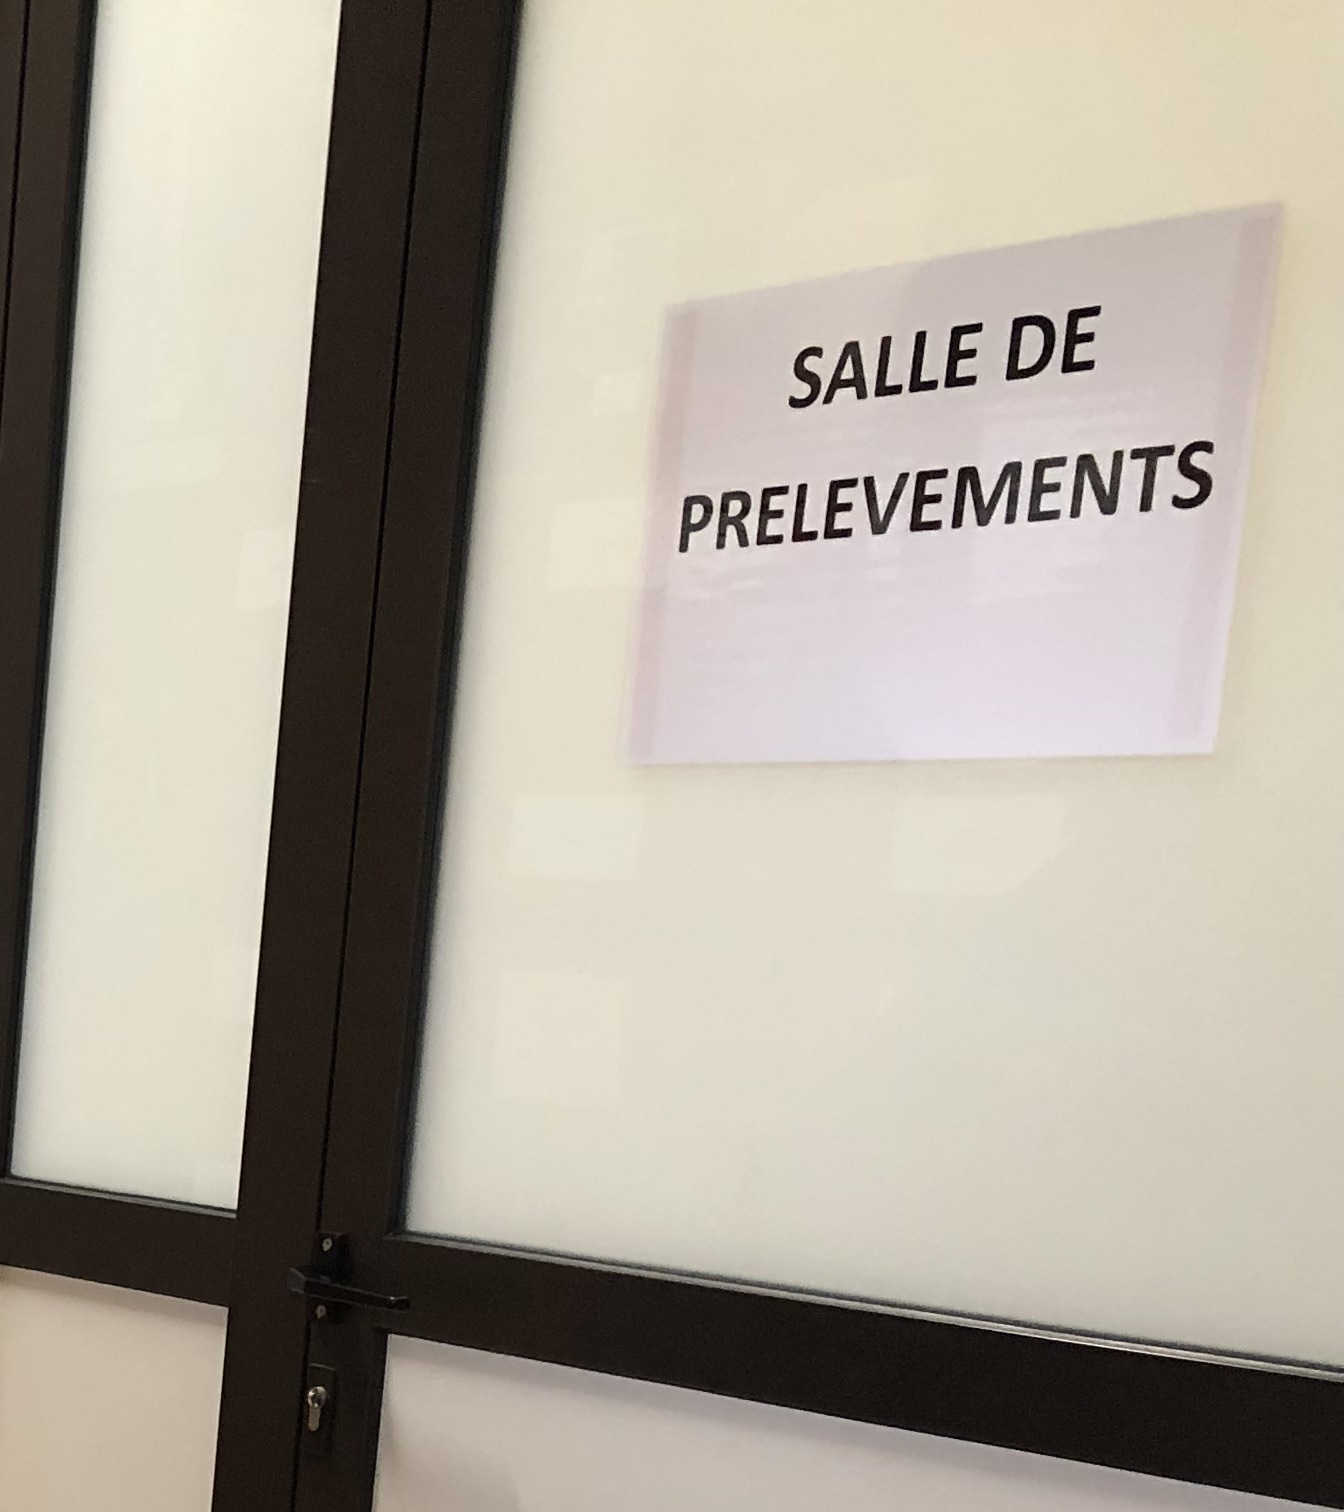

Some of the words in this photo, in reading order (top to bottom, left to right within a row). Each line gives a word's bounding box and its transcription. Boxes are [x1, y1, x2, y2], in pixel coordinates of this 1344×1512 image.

[788, 322, 983, 409] SALLE
[1005, 305, 1102, 382] DE
[678, 440, 1214, 554] PRELEVEMENTS
